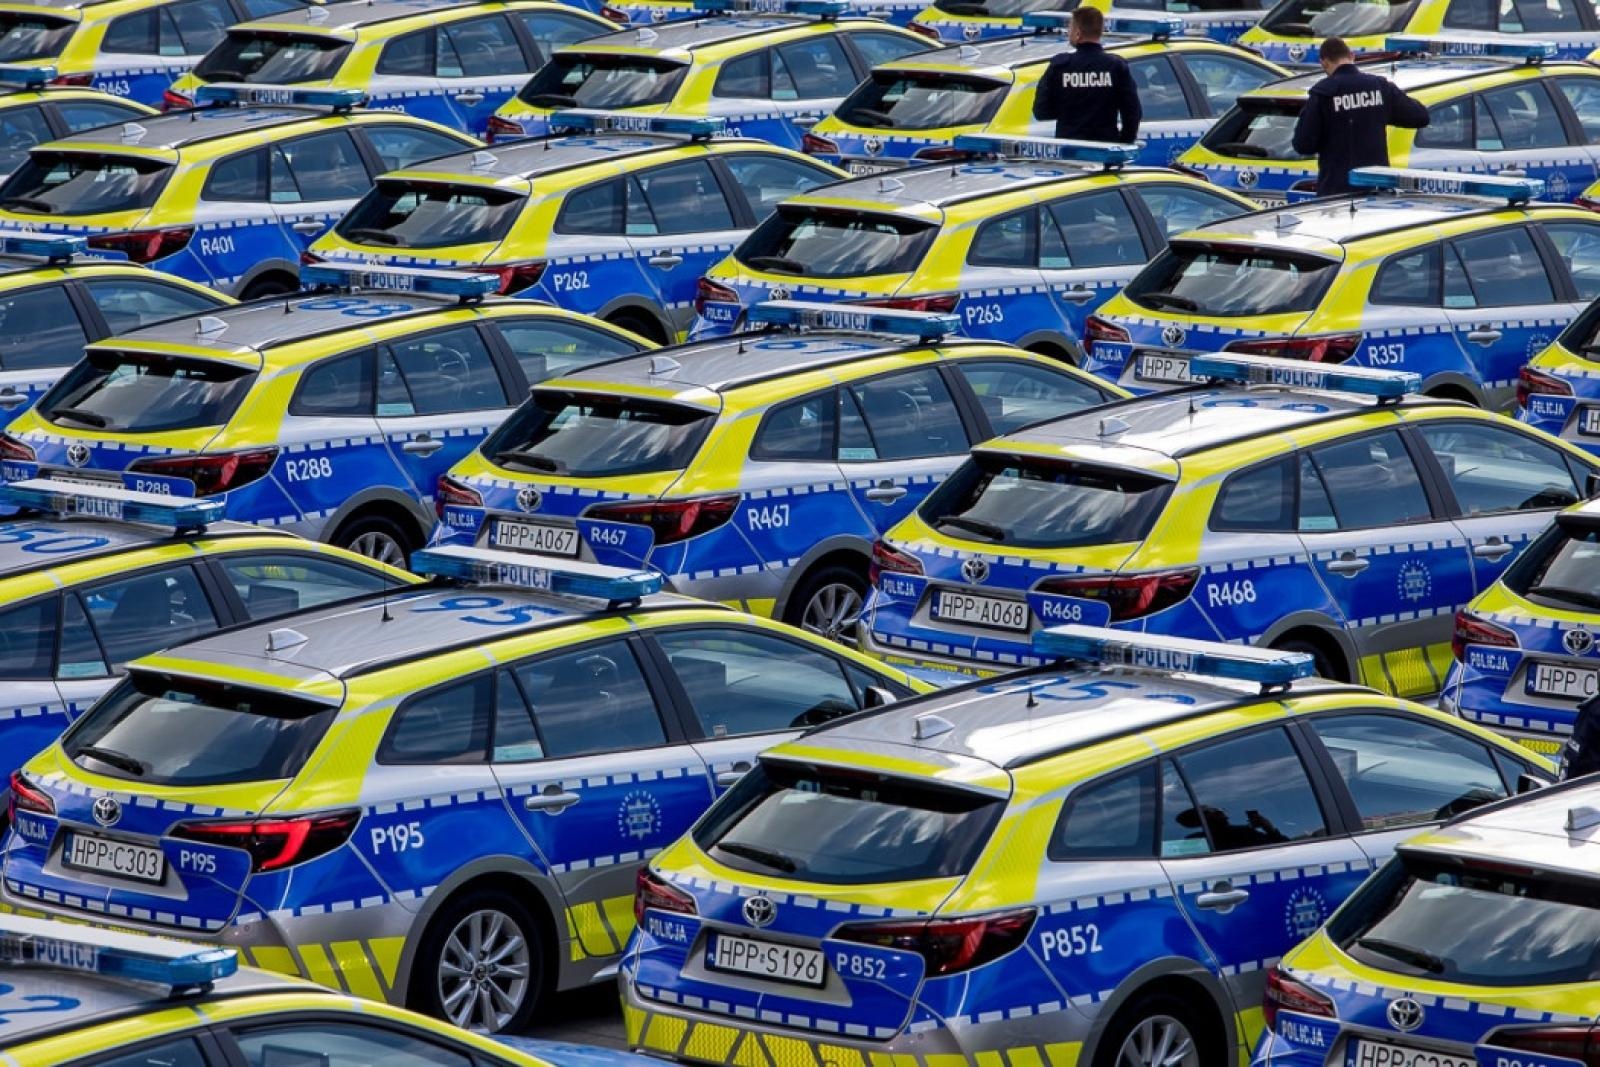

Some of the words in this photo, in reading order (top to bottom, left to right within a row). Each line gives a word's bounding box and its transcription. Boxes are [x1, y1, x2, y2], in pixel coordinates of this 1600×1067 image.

[1062, 72, 1112, 88] POLICJA
[1333, 90, 1383, 112] POLICJA
[200, 235, 236, 256] R401
[552, 270, 591, 292] P262
[825, 312, 868, 330] POLICJ
[965, 304, 1003, 326] P263
[1367, 343, 1404, 366] R357
[1144, 357, 1173, 378] HPP
[285, 457, 333, 482] R288
[136, 479, 171, 497] R288
[77, 498, 122, 518] POLICJ
[747, 504, 789, 531] R467
[499, 523, 530, 546] HPP
[534, 528, 574, 552] A067
[591, 526, 627, 545] R467
[499, 565, 549, 588] POLICJ
[1207, 579, 1257, 607] R468
[942, 594, 976, 619] HPP
[980, 600, 1023, 626] A068
[1043, 599, 1082, 621] R468
[1135, 648, 1191, 670] POLICJ
[1539, 668, 1577, 693] HPP
[371, 821, 425, 855] P195
[74, 838, 109, 867] HPP
[113, 846, 158, 876] C303
[180, 849, 216, 873] P195
[36, 938, 96, 969] POLICJ
[1040, 924, 1103, 961] P852
[719, 938, 760, 969] HPP
[765, 947, 819, 980] S196
[837, 951, 886, 980] P852
[1281, 1020, 1325, 1047] POLICJA
